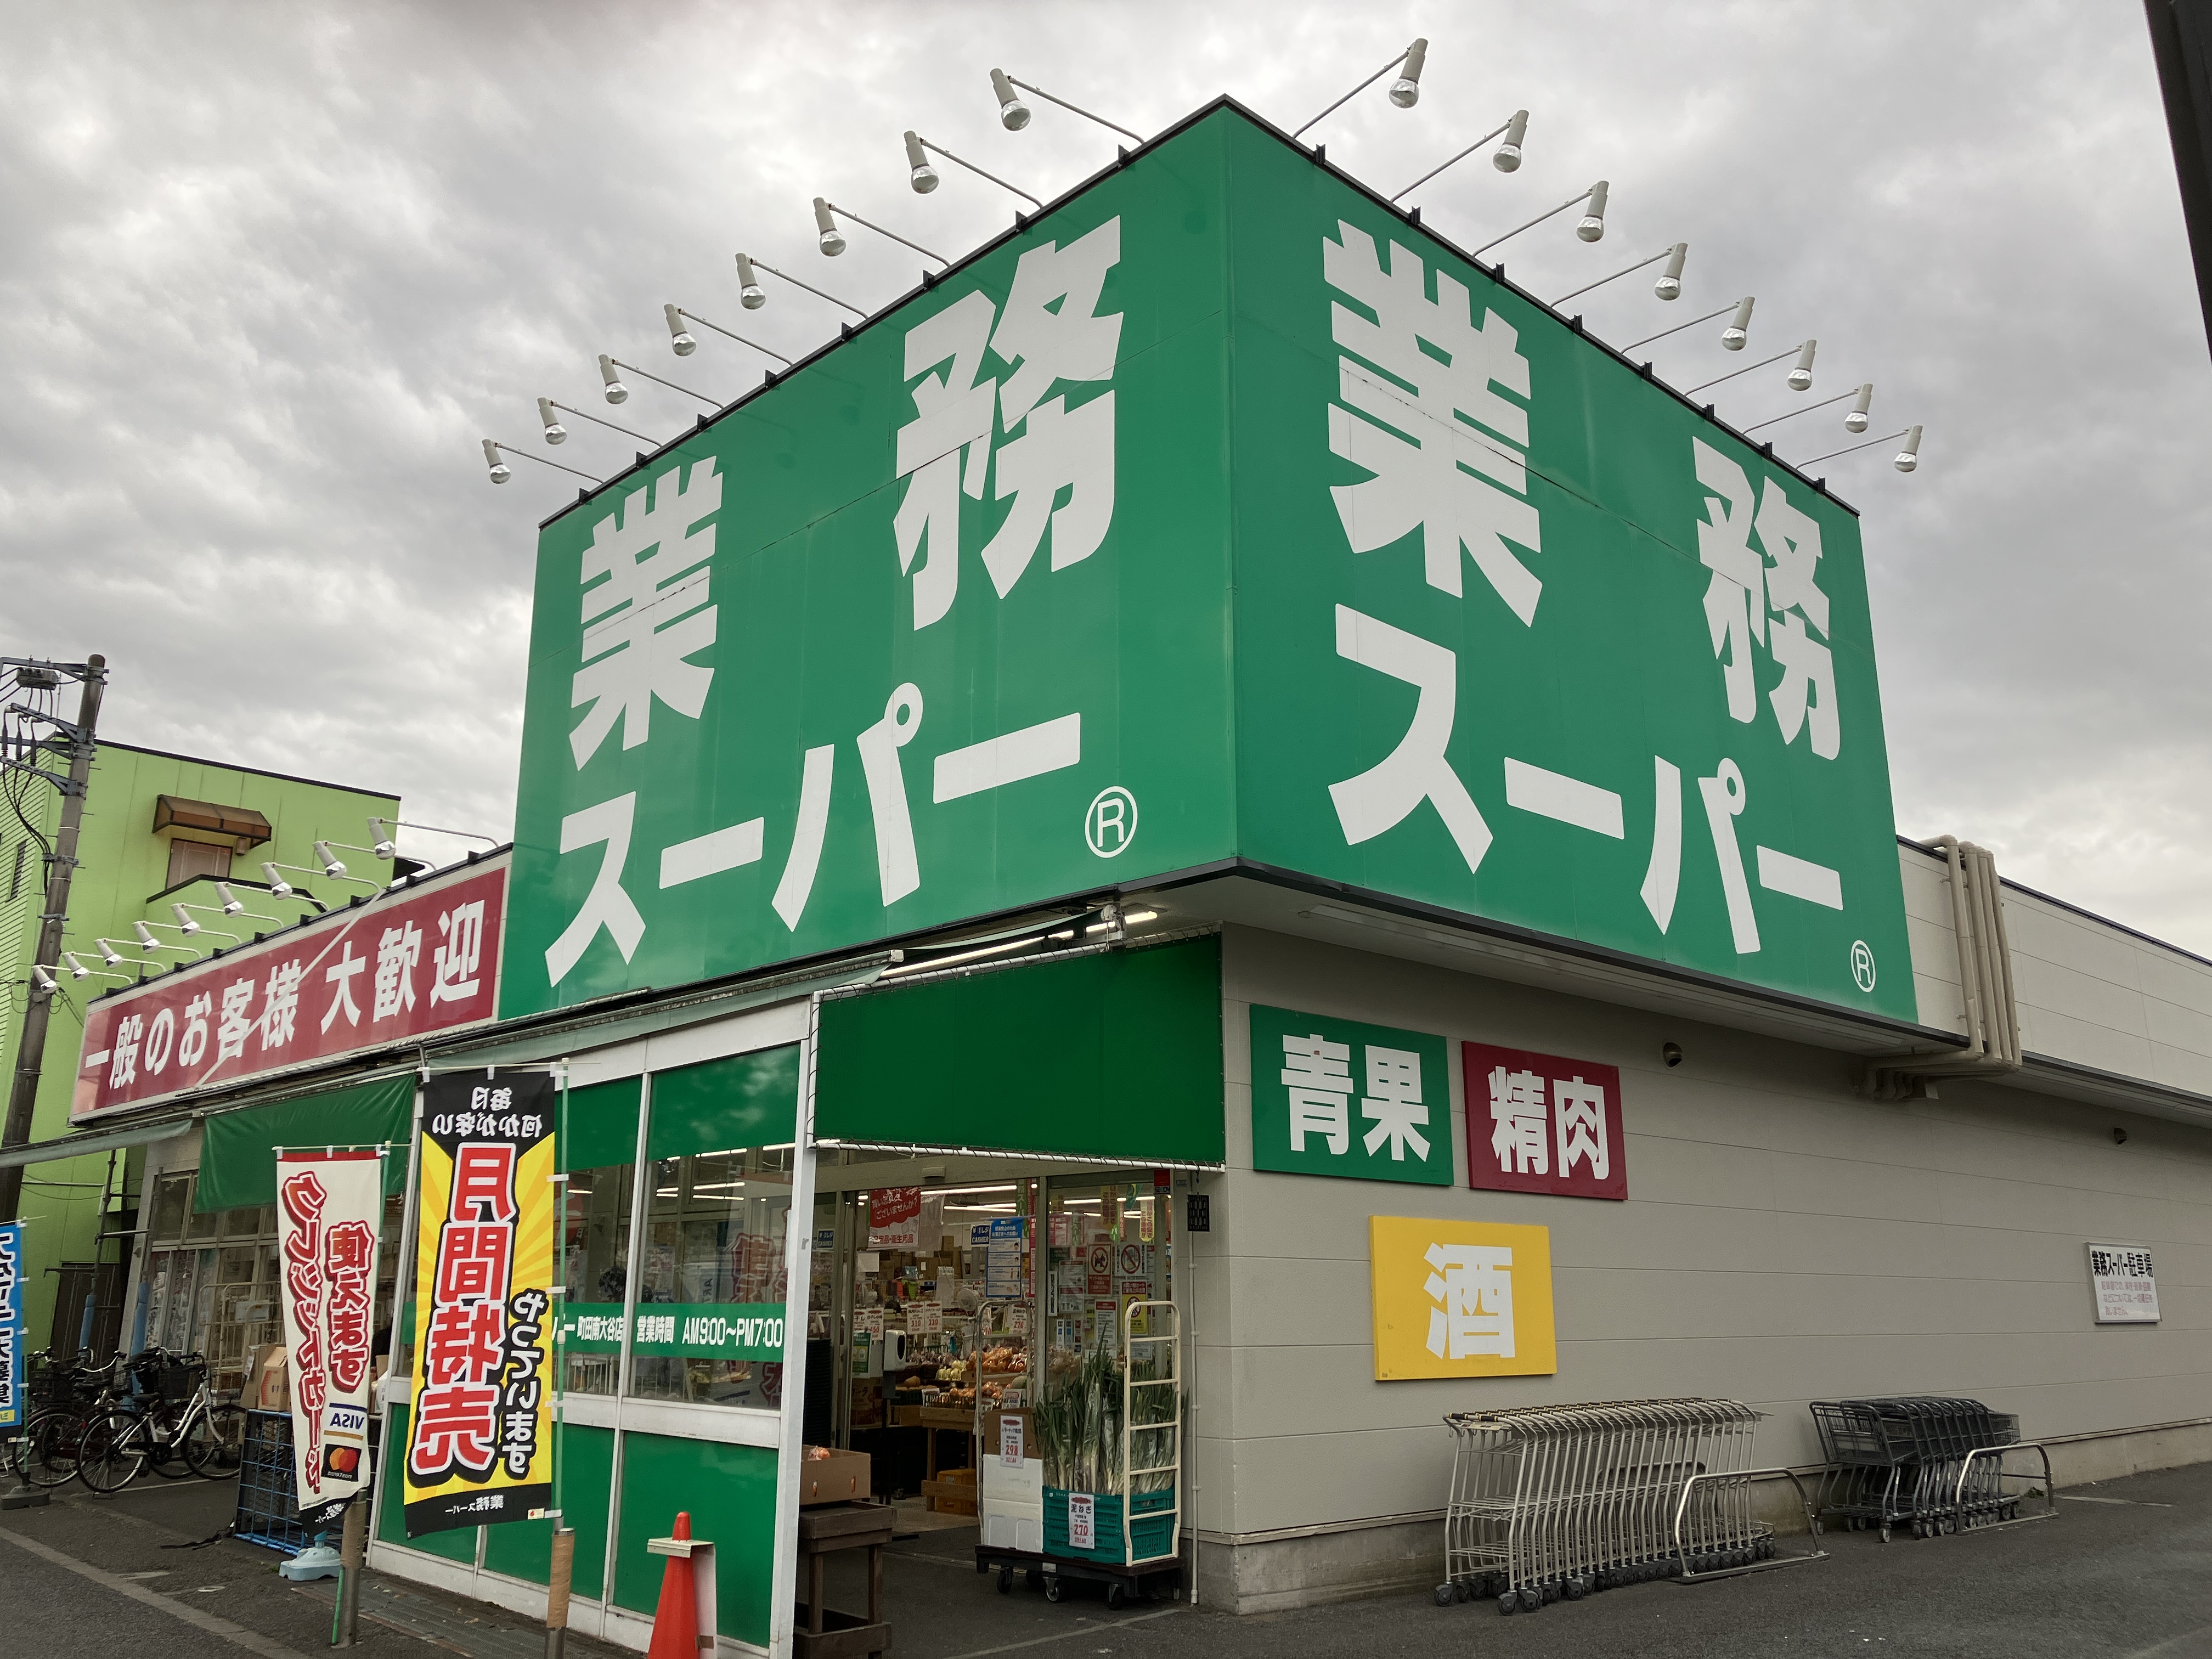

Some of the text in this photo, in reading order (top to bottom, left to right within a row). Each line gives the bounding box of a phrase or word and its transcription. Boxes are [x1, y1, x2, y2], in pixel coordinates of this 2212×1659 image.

[569, 215, 1124, 770] 業務
[1323, 219, 1839, 760] 業務
[545, 682, 1080, 986] スーパー
[1328, 603, 1843, 953] スーパー
[85, 899, 485, 1089] 一般のお客様 大歓迎
[1281, 1034, 1430, 1162] 青果
[1488, 1065, 1609, 1180] 精肉
[636, 1315, 675, 1344] 営業時間
[1423, 1242, 1515, 1359] 酒
[1005, 1444, 1019, 1455] 298
[1074, 1523, 1088, 1536] 270
